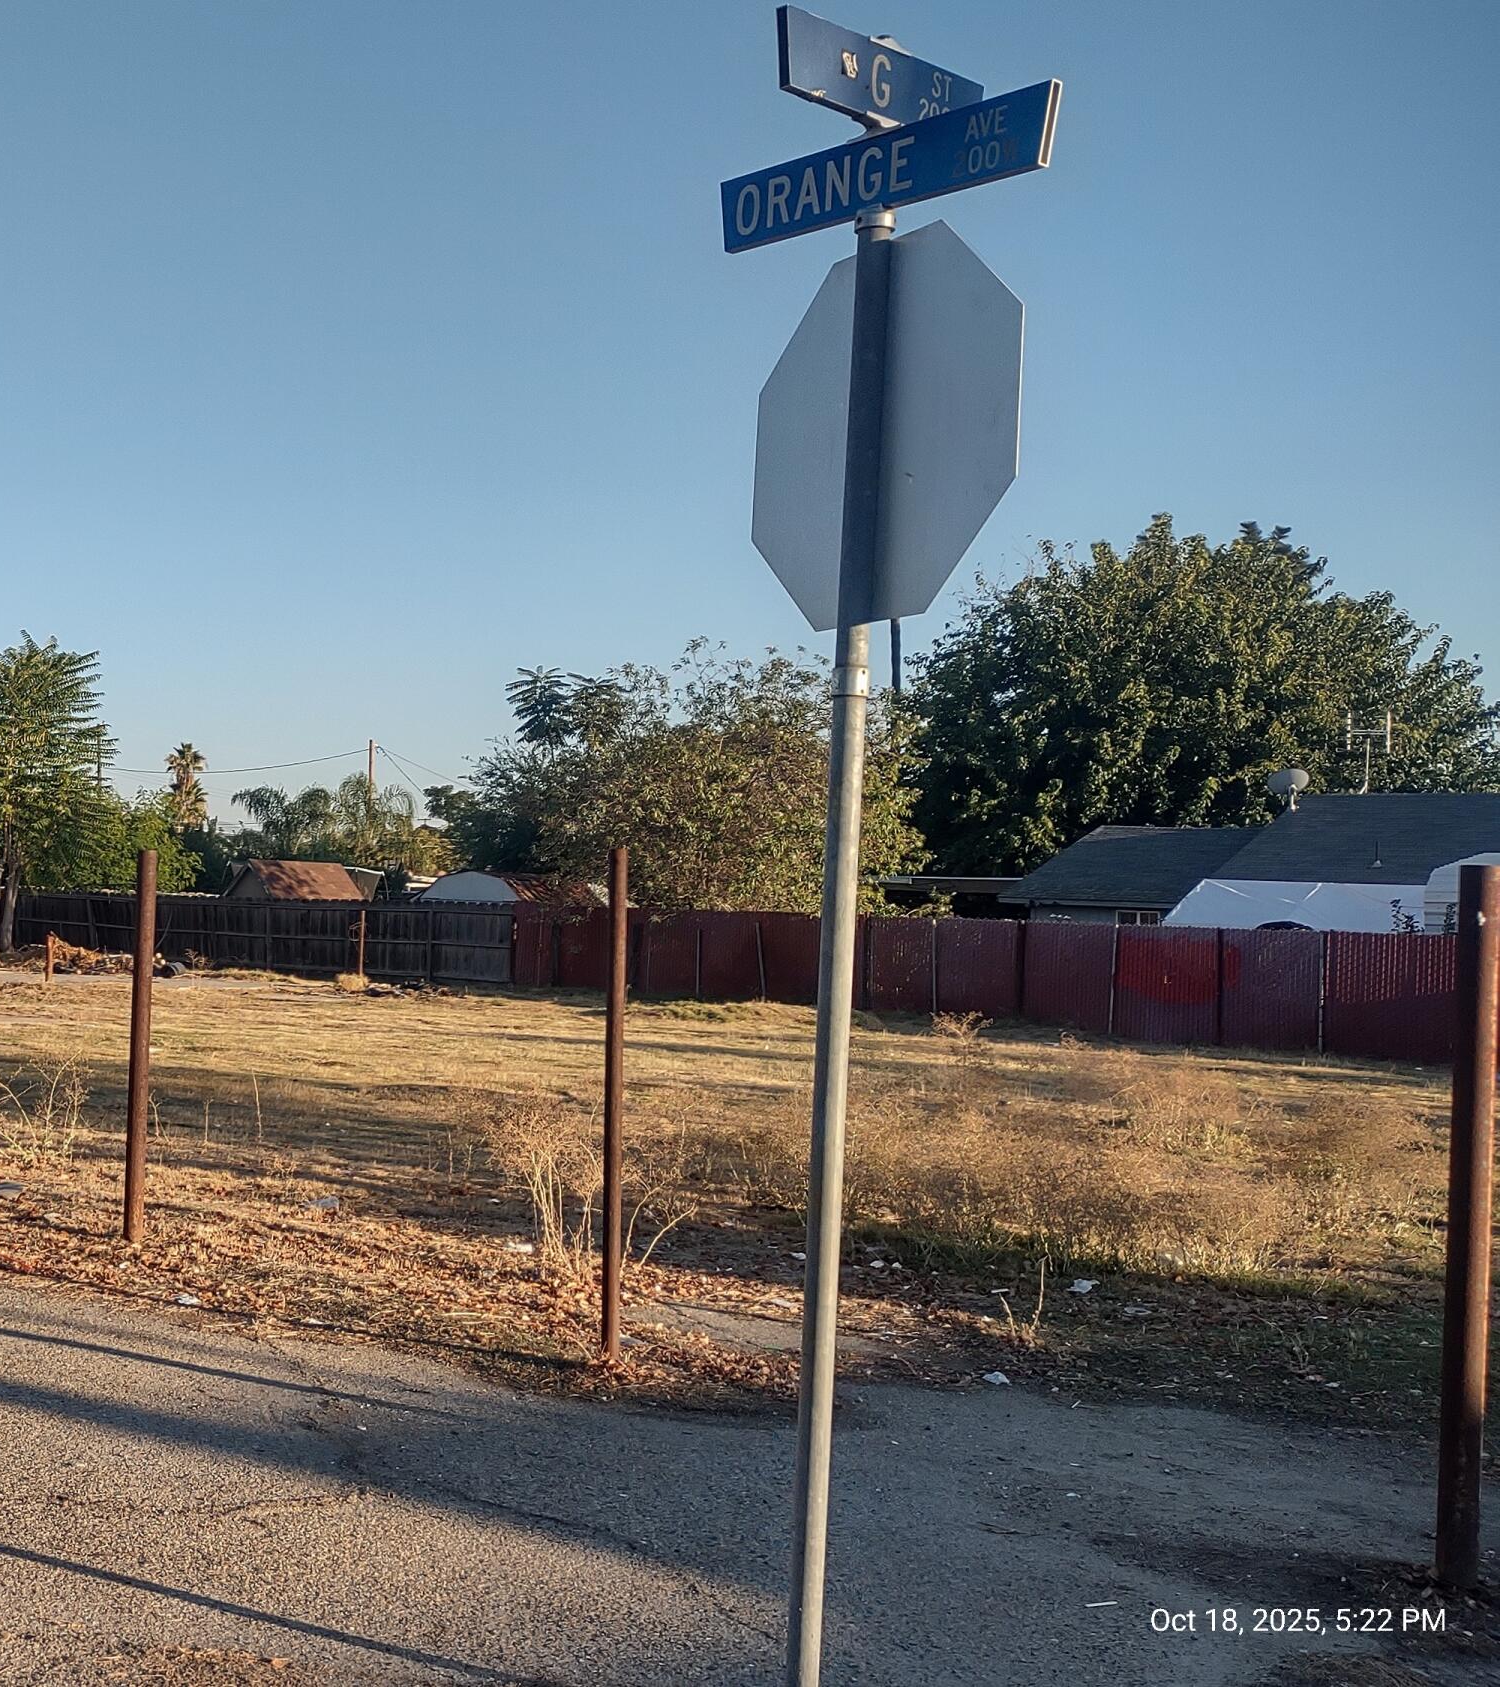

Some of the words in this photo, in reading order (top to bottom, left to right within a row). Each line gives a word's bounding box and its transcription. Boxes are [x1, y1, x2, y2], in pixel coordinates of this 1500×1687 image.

[871, 55, 892, 108] G
[932, 71, 952, 102] ST
[735, 136, 916, 236] ORANGE
[964, 105, 1009, 143] AVE
